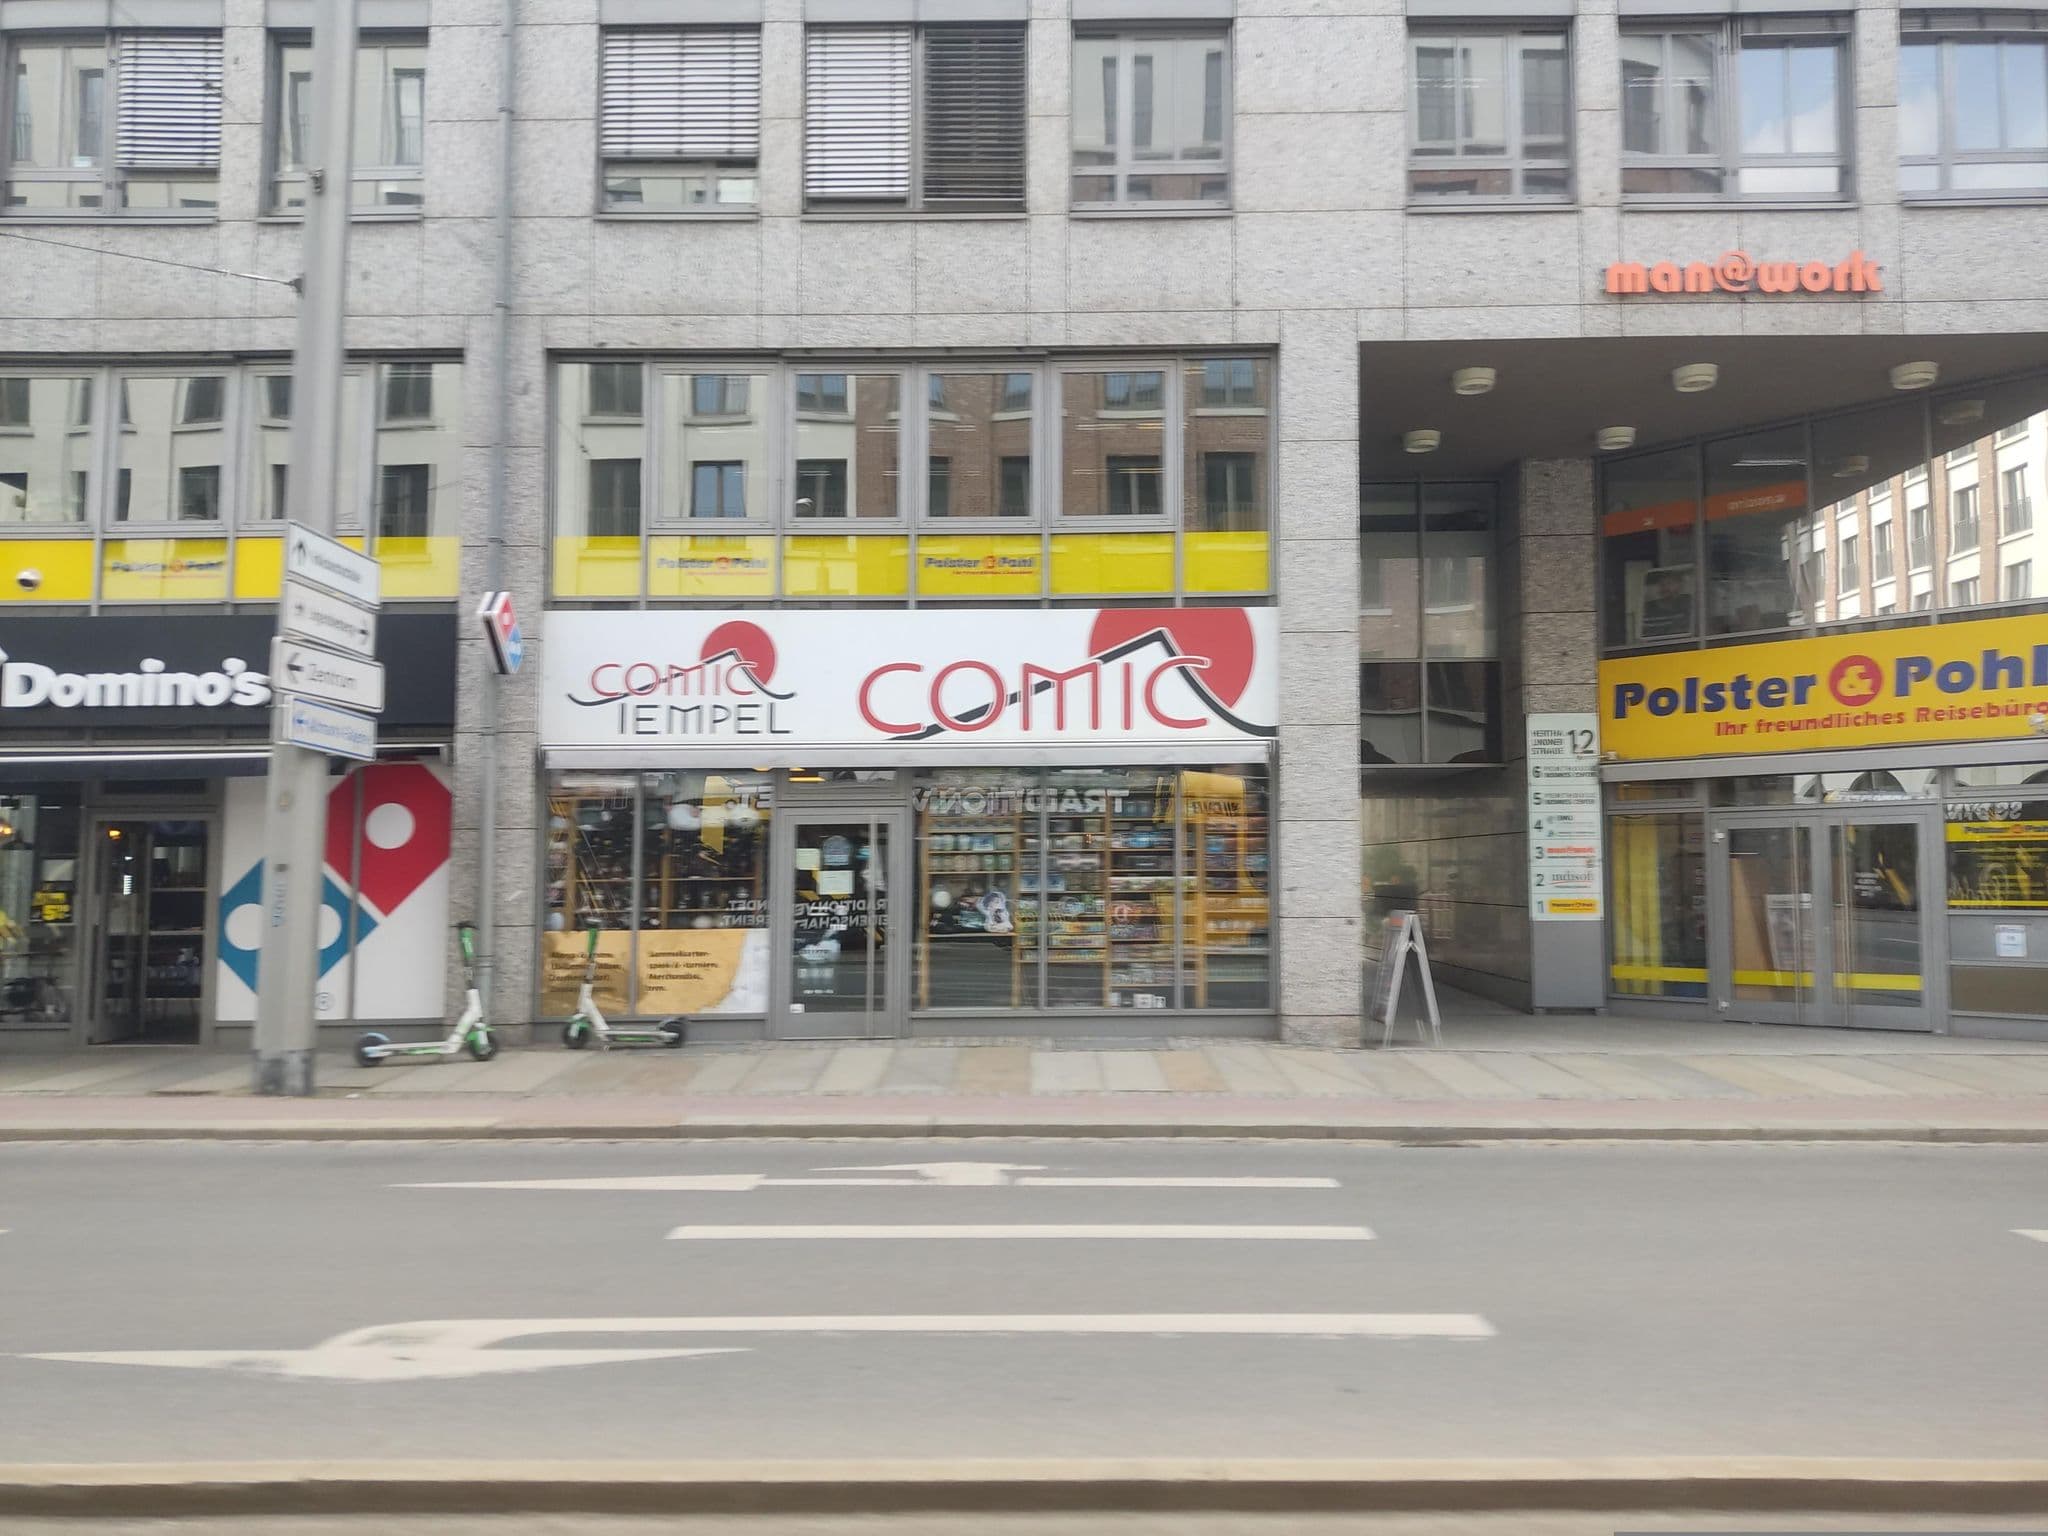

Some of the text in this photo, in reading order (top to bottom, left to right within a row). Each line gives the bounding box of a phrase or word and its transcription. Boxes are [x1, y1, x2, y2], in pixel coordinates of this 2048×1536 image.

[1606, 249, 1882, 293] man@work
[2, 658, 272, 707] Domino's
[590, 661, 757, 697] COMIC
[1614, 645, 2048, 719] Polster & Pohl
[858, 658, 1210, 732] COMIC
[1716, 721, 1748, 736] Ihr
[1756, 710, 1905, 734] freundliches
[1567, 729, 1594, 754] 12
[1532, 766, 1541, 778] 6
[1532, 792, 1541, 805] 5
[1534, 819, 1543, 832] 4
[1535, 846, 1544, 859] 3
[1536, 873, 1545, 887] 2
